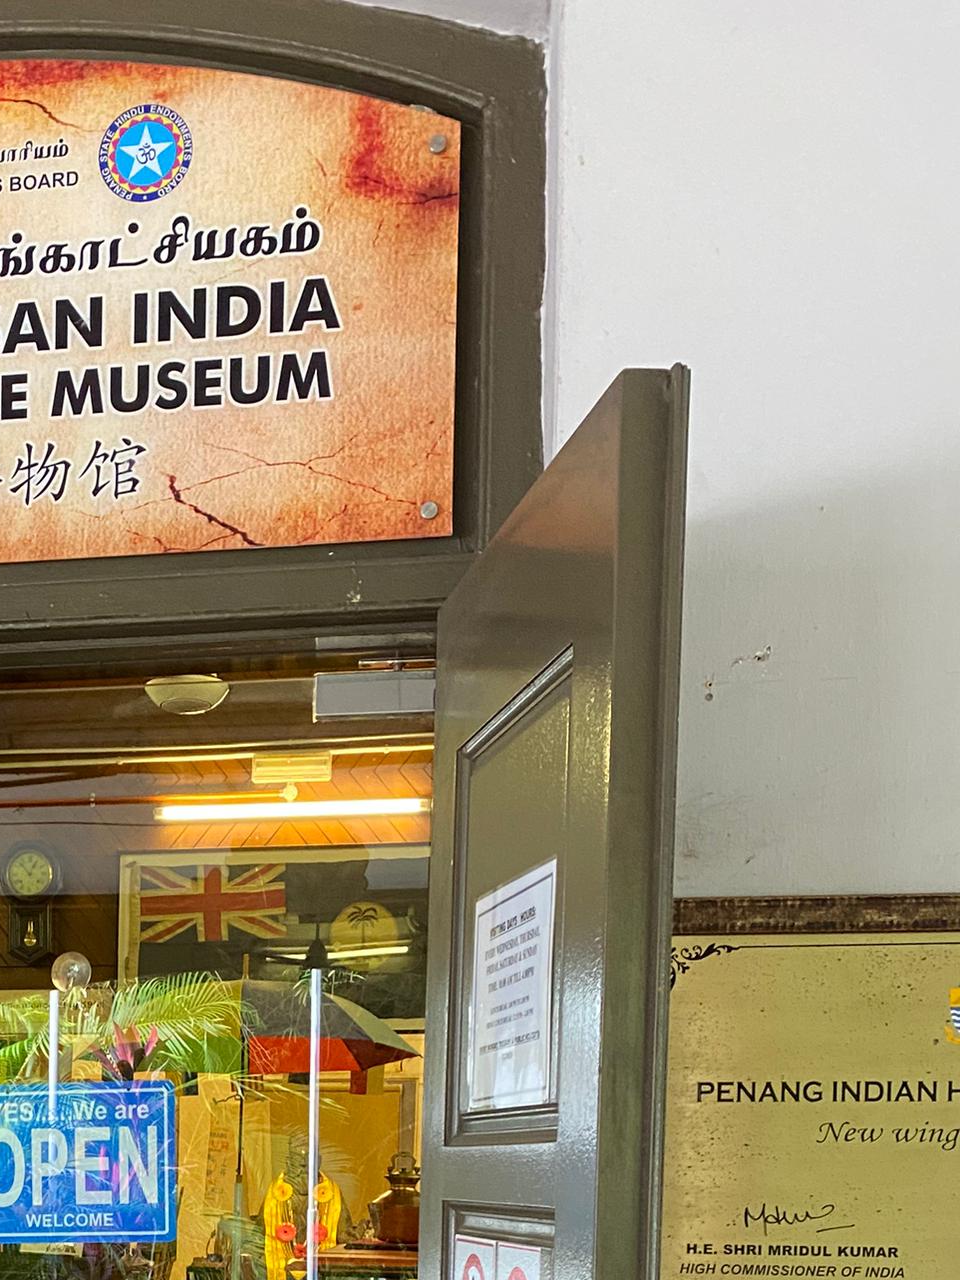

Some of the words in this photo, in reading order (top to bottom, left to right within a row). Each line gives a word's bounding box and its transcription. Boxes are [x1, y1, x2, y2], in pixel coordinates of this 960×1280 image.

[114, 105, 145, 128] HINDU
[149, 104, 193, 161] ENDOWMENTS
[99, 129, 116, 163] STATE
[9, 170, 80, 192] BOARD
[101, 167, 134, 201] PENANG
[157, 166, 188, 197] BOARD
[134, 278, 341, 344] INDIA
[51, 351, 332, 417] MUSEUM
[696, 1081, 823, 1103] PENANG
[832, 1081, 938, 1103] INDIAN
[115, 1104, 149, 1119] are
[816, 1121, 884, 1145] New
[25, 1212, 114, 1228] WELCOME
[686, 1243, 718, 1256] H.E.
[723, 1243, 763, 1256] SHRI
[768, 1244, 833, 1258] MRIDUL
[837, 1245, 899, 1259] KUMAR
[679, 1263, 717, 1275] HIGH
[720, 1263, 839, 1278] COMMISSIONER
[841, 1265, 862, 1277] OF
[865, 1266, 906, 1279] INDIA
